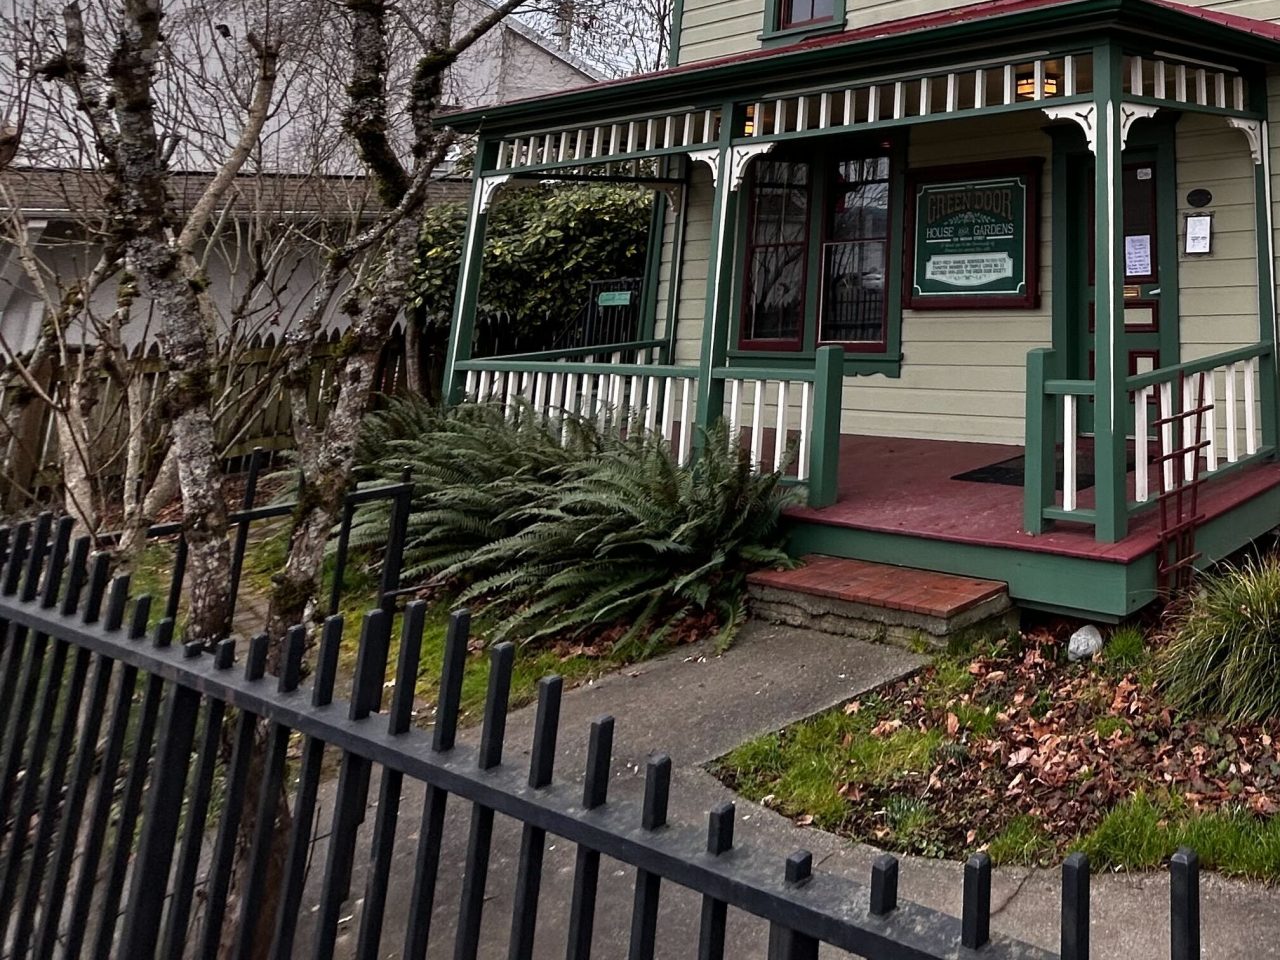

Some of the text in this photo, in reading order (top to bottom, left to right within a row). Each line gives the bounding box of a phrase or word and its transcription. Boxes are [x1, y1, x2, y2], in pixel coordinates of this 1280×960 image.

[927, 189, 1013, 224] GREEN DOOR
[926, 226, 954, 238] HOUSE
[973, 223, 1014, 235] GARDENS
